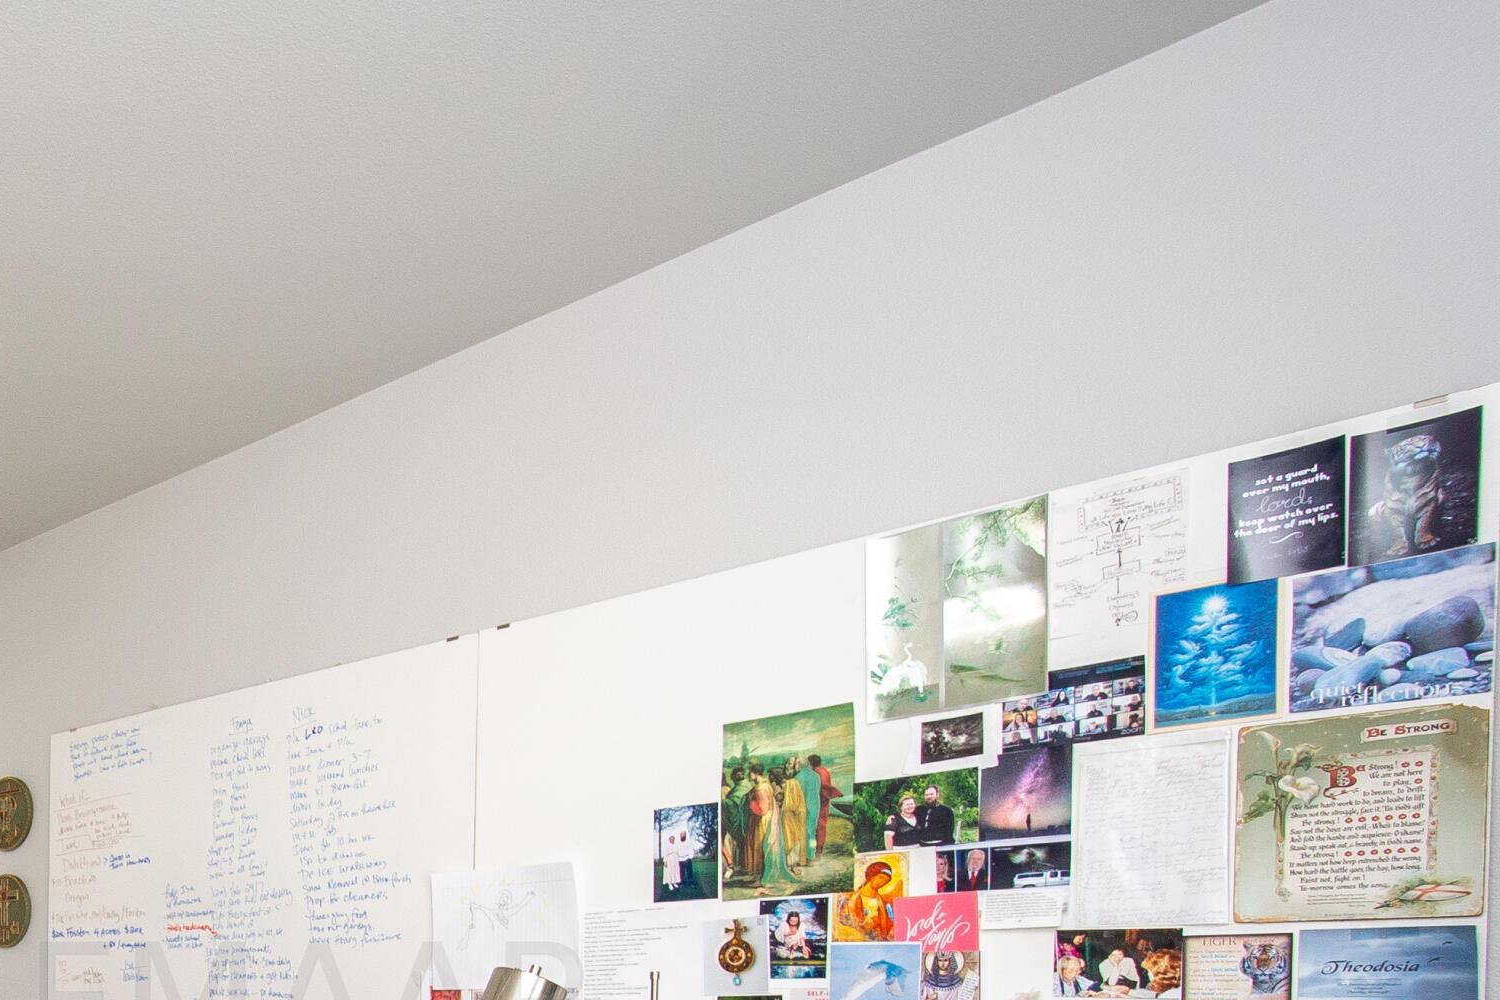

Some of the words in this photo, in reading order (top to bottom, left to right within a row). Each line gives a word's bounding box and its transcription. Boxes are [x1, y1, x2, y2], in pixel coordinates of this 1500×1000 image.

[1285, 464, 1317, 481] guard
[1242, 488, 1269, 498] over
[1272, 483, 1289, 492] my
[1291, 472, 1330, 488] mouth,
[1268, 509, 1303, 523] watch
[1305, 503, 1333, 515] over
[1234, 529, 1252, 538] the
[1255, 524, 1280, 535] door
[1283, 519, 1296, 529] of
[1298, 517, 1315, 526] my
[1318, 512, 1339, 523] lips.
[1311, 681, 1364, 704] quiet
[1341, 681, 1460, 707] reflections
[1321, 960, 1420, 975] Theodosia
